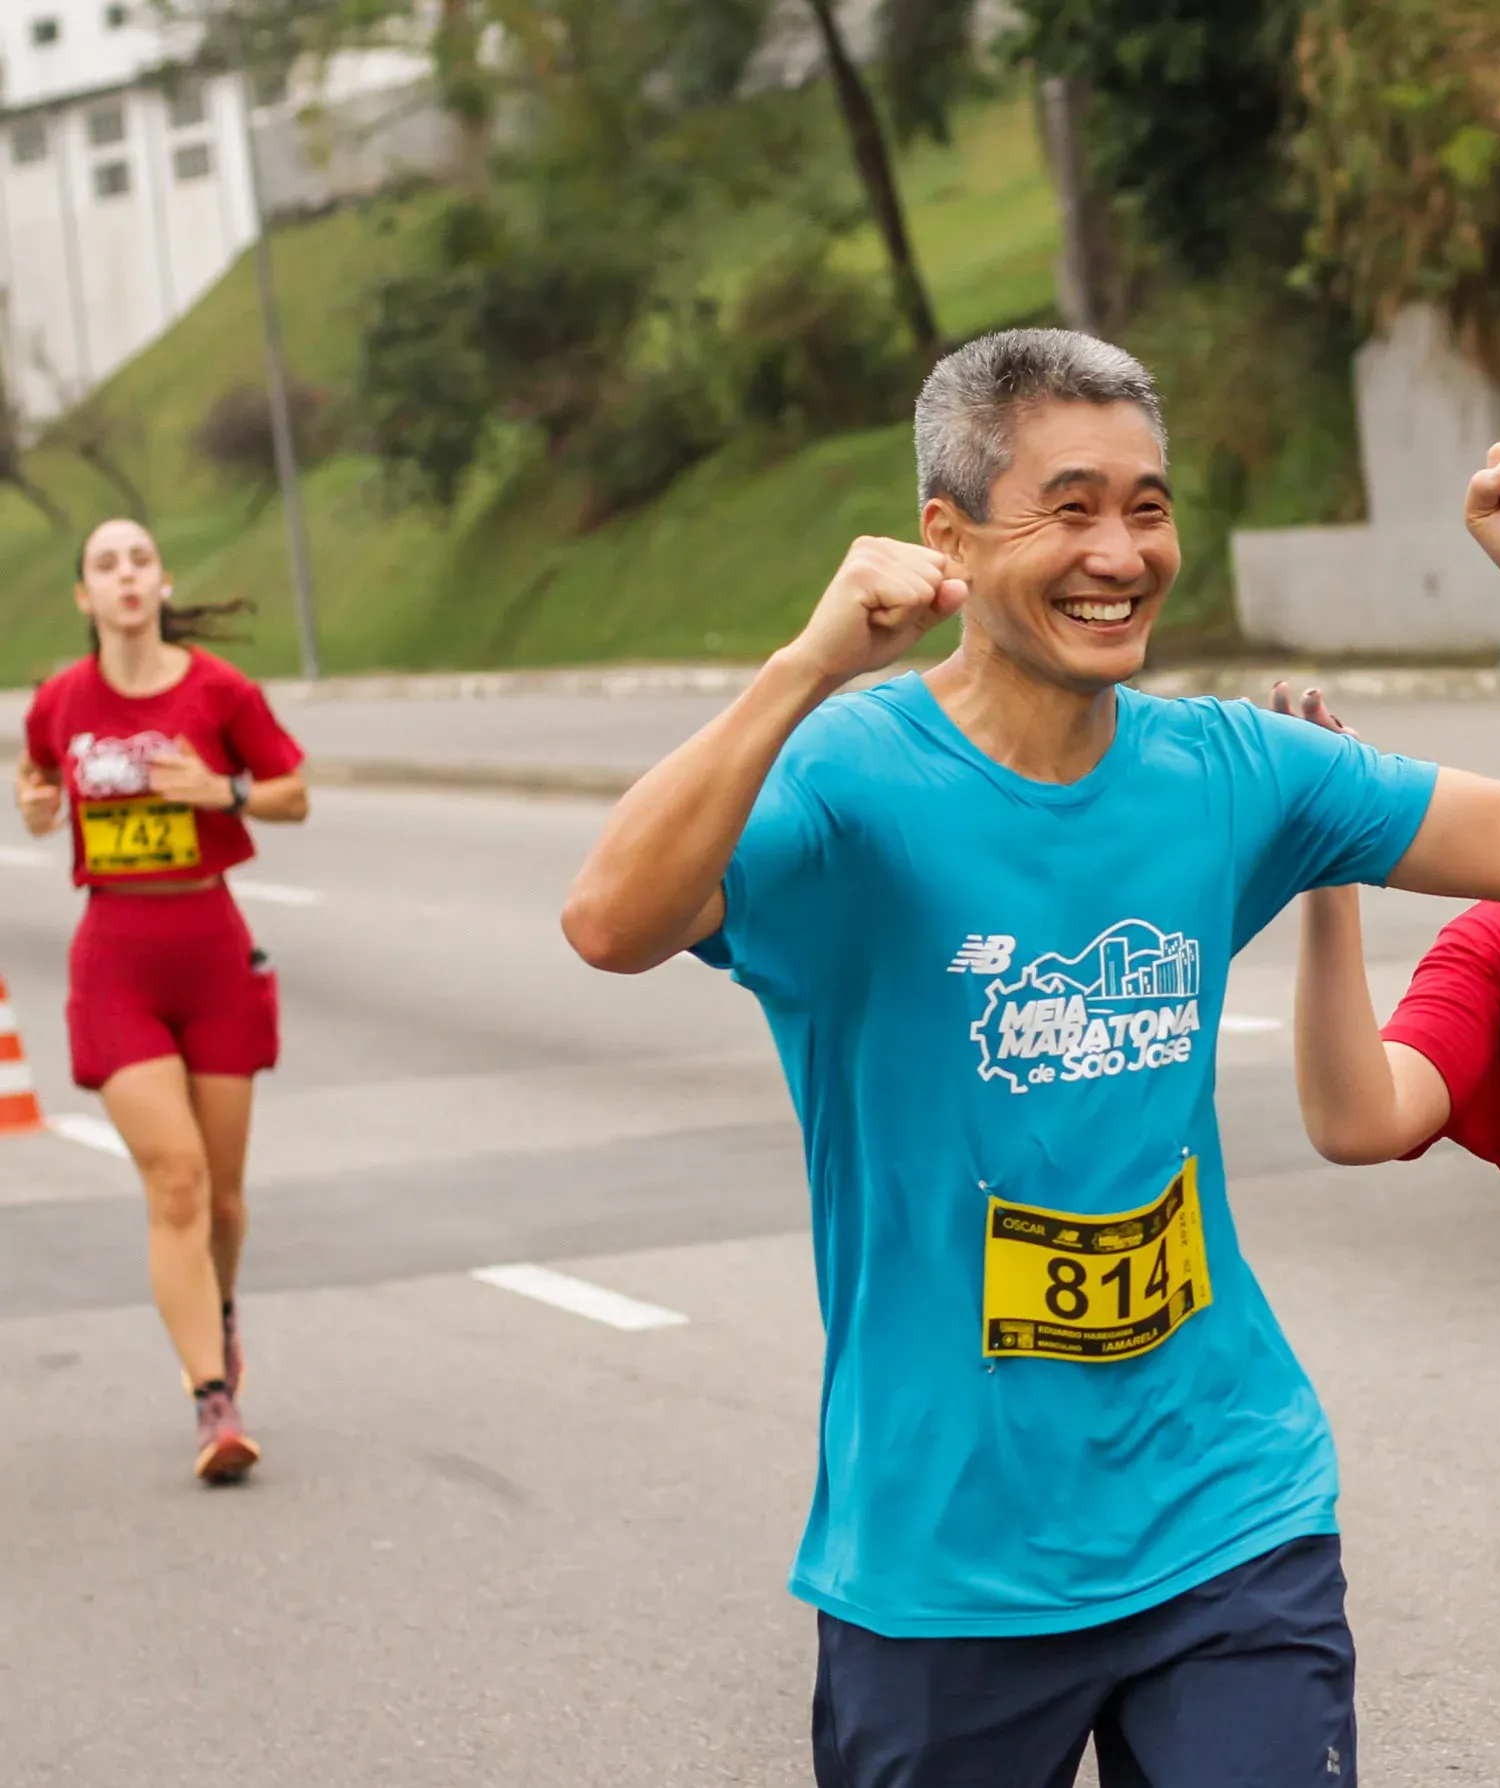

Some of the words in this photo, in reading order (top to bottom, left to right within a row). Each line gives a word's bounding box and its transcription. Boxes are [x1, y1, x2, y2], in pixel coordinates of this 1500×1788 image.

[947, 934, 1016, 974] NB
[997, 1000, 1200, 1059] MARATONA
[998, 994, 1088, 1032] MEIA
[1028, 1063, 1056, 1083] de
[1060, 1045, 1125, 1081] São
[1127, 1030, 1191, 1071] José
[1003, 1217, 1045, 1236] OSCAR
[1045, 1236, 1169, 1321] 814
